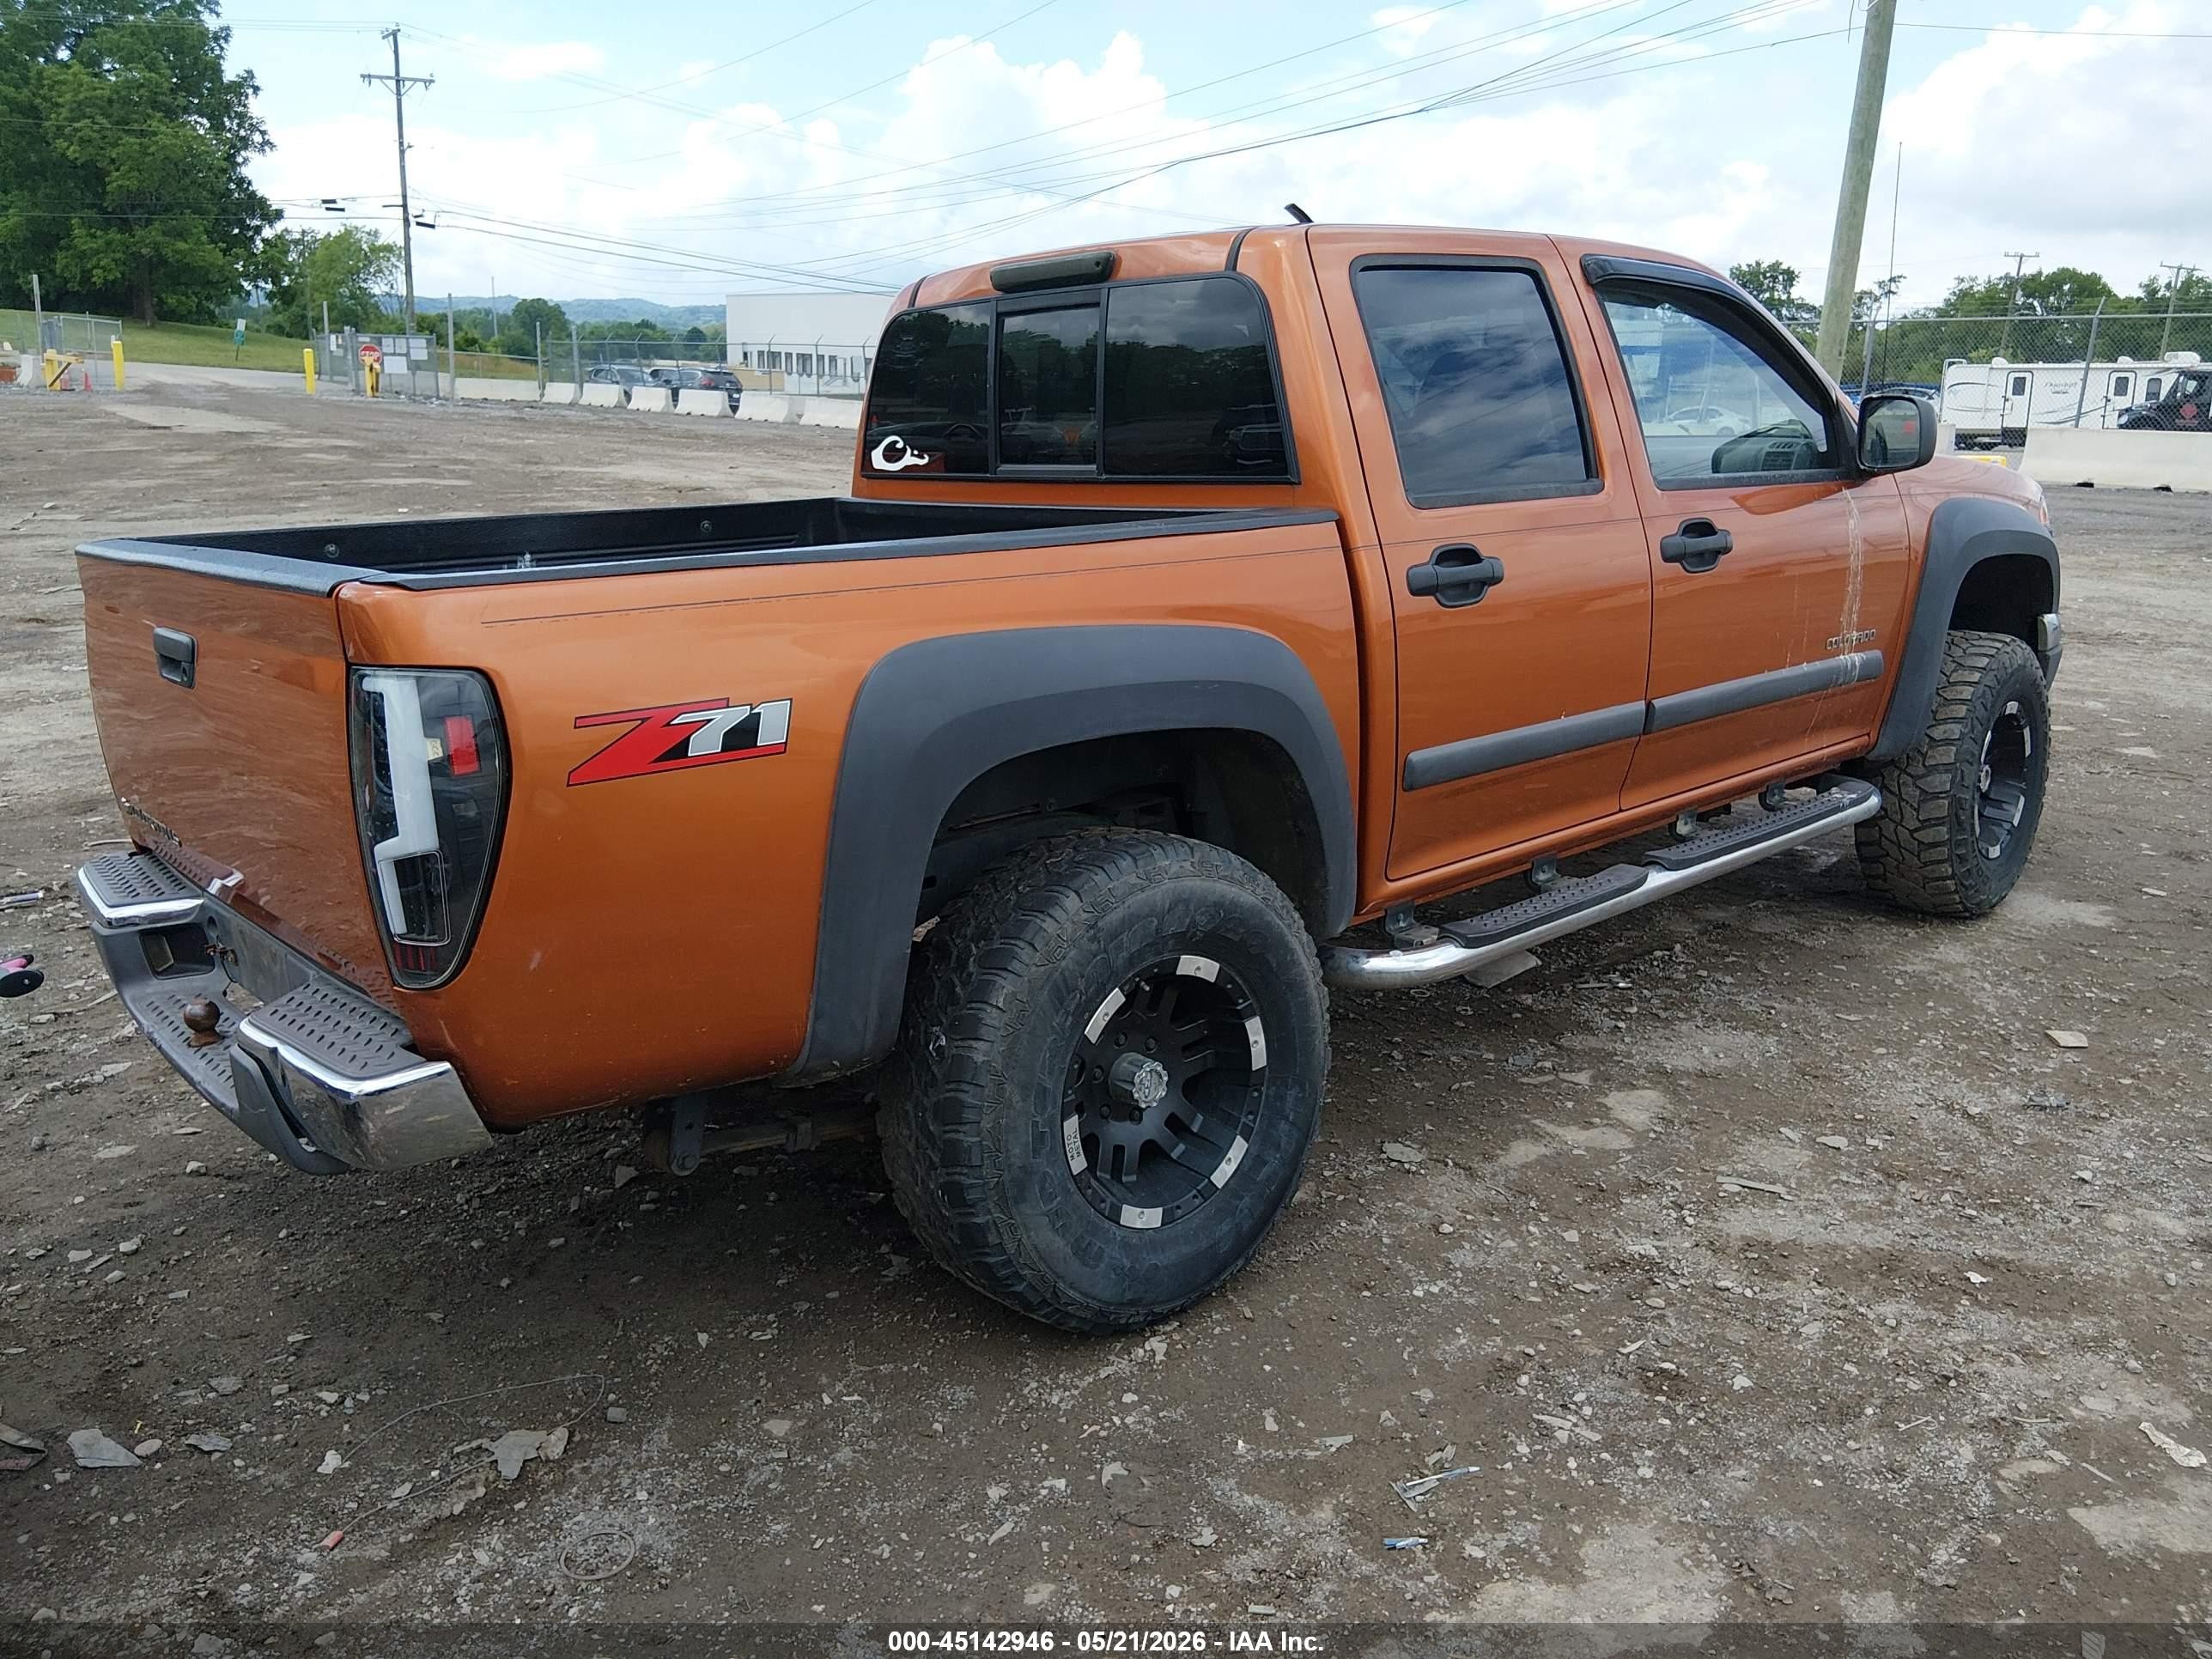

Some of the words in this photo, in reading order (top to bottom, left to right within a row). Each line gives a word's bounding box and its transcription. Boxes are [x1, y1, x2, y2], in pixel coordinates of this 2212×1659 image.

[1826, 629, 1876, 649] COLORADO
[567, 697, 793, 787] Z71
[1066, 1134, 1075, 1162] MOTO
[1072, 1127, 1082, 1158] METAL
